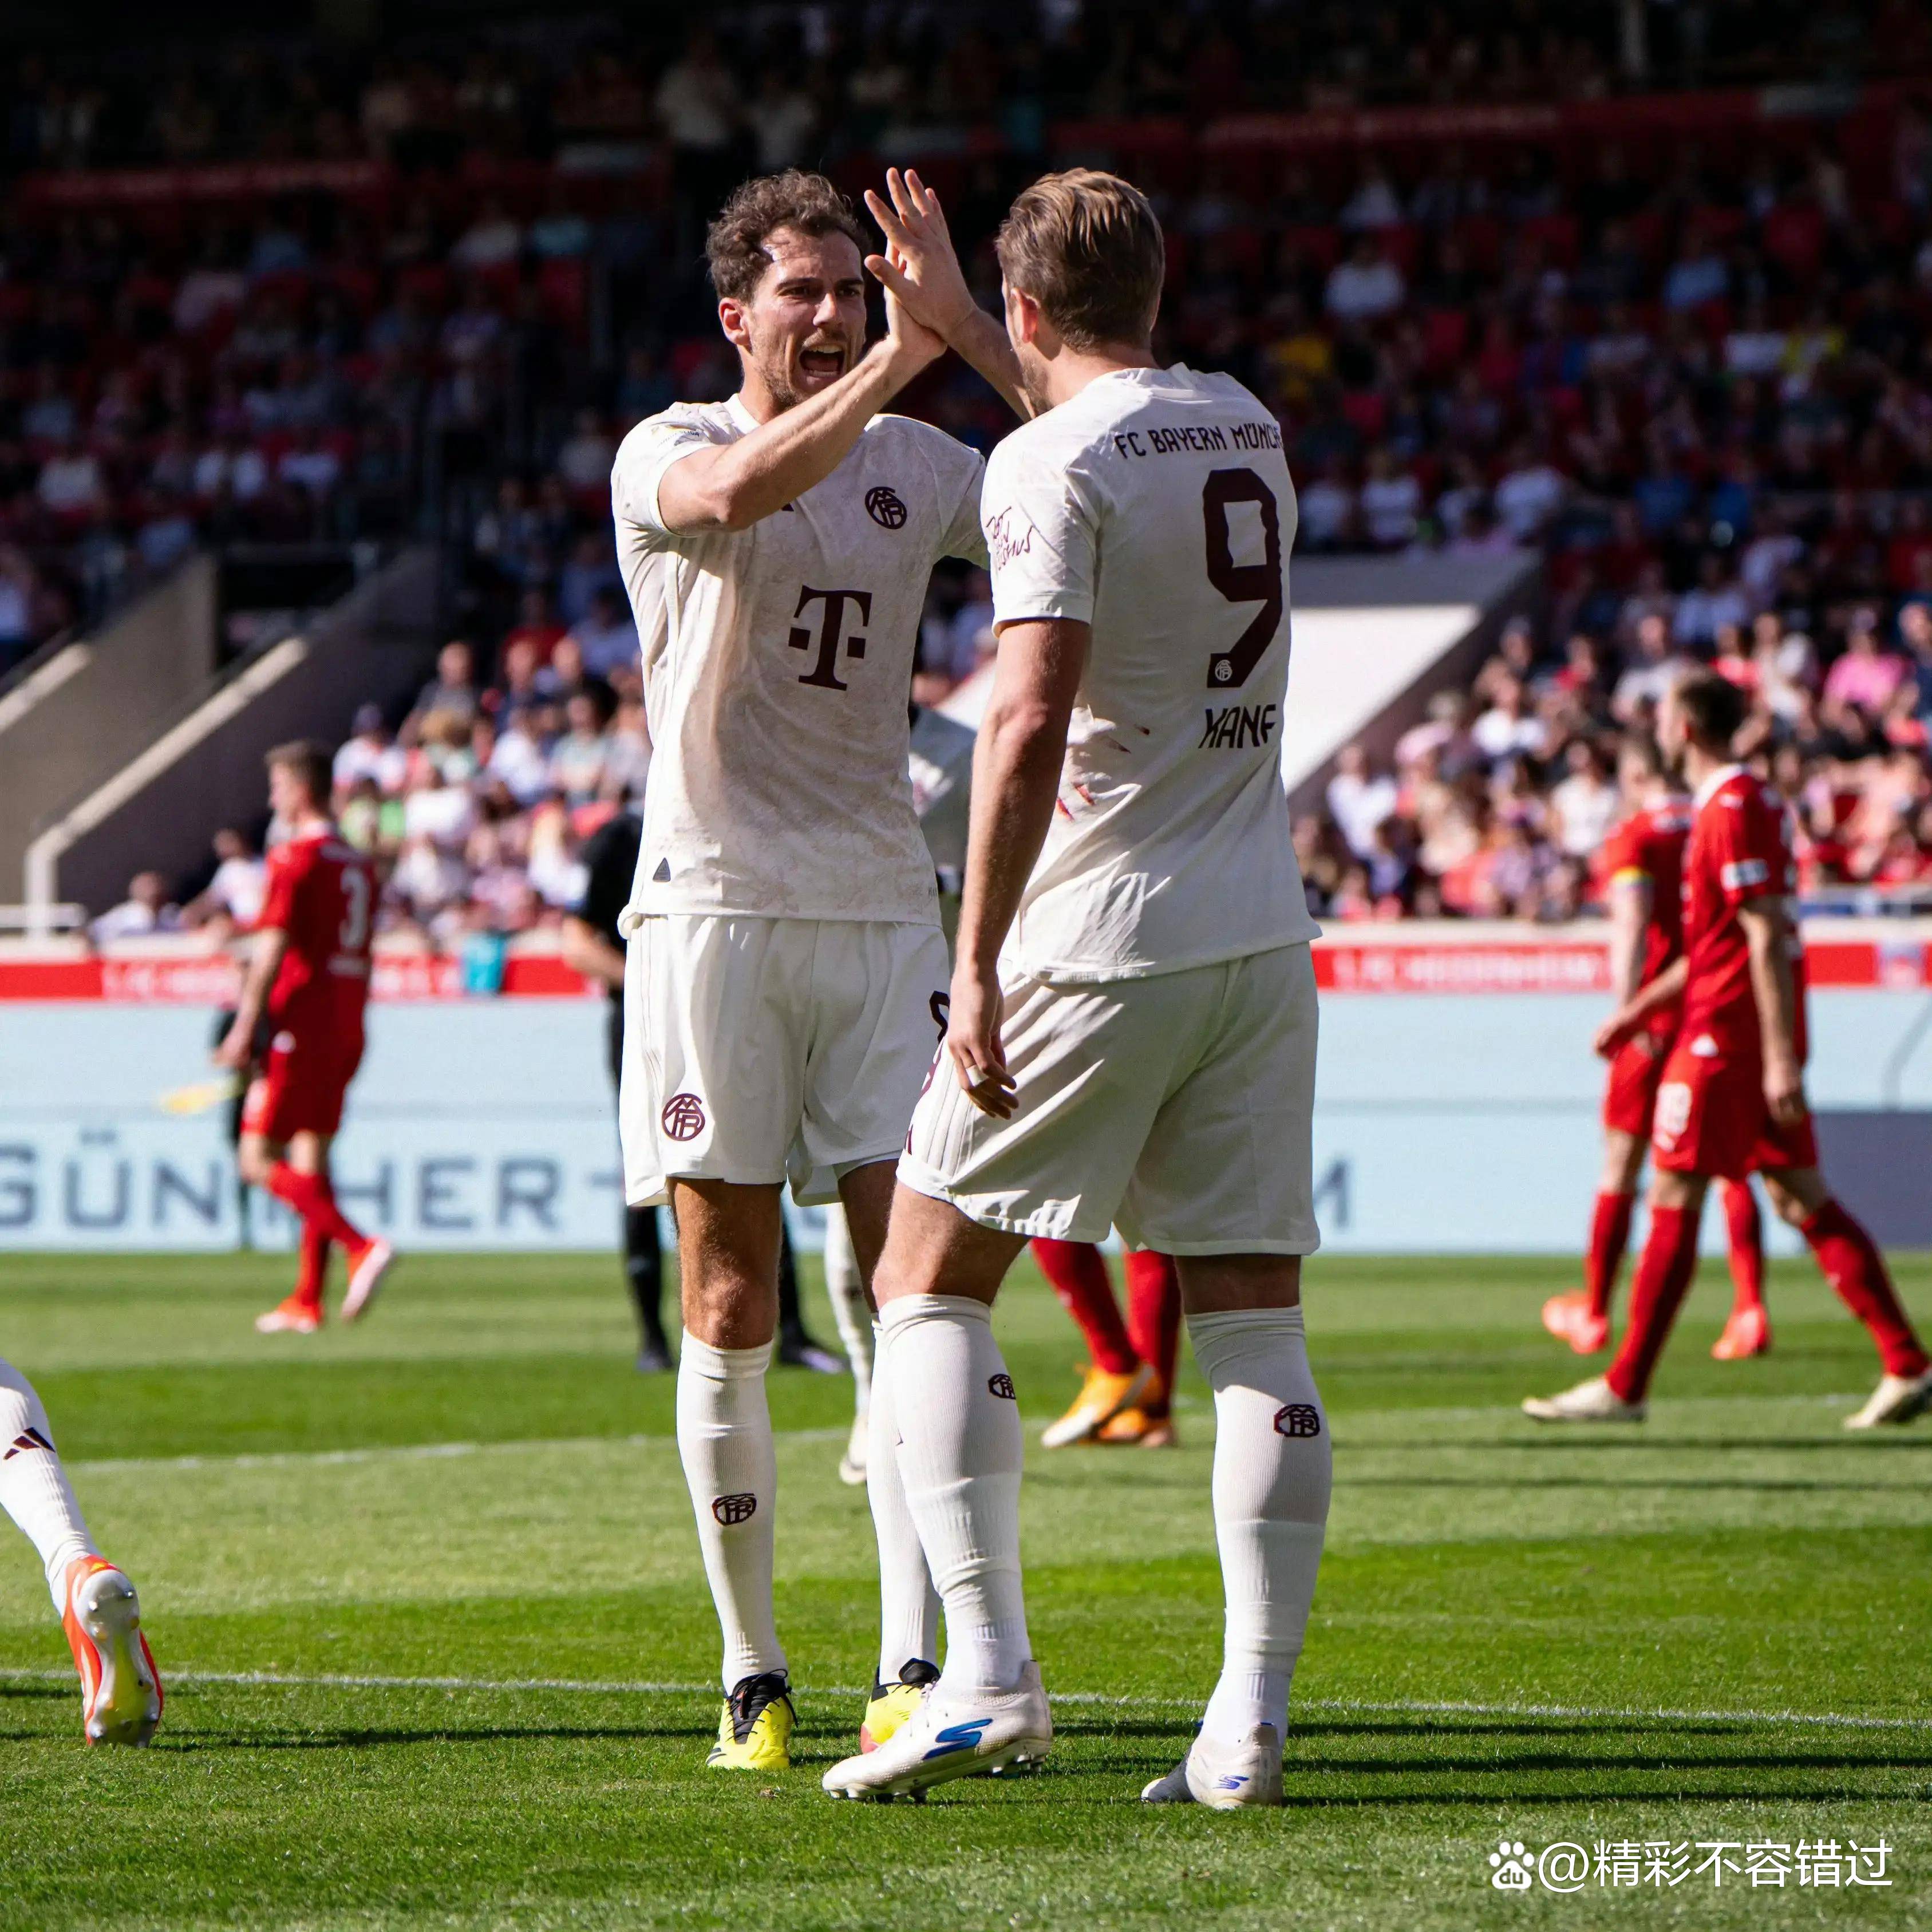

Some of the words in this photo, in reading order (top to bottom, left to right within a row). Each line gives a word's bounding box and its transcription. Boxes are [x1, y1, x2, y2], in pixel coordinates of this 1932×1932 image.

[1114, 432, 1147, 460] FC
[1147, 426, 1228, 454] BAYERN
[1202, 467, 1283, 688] 9
